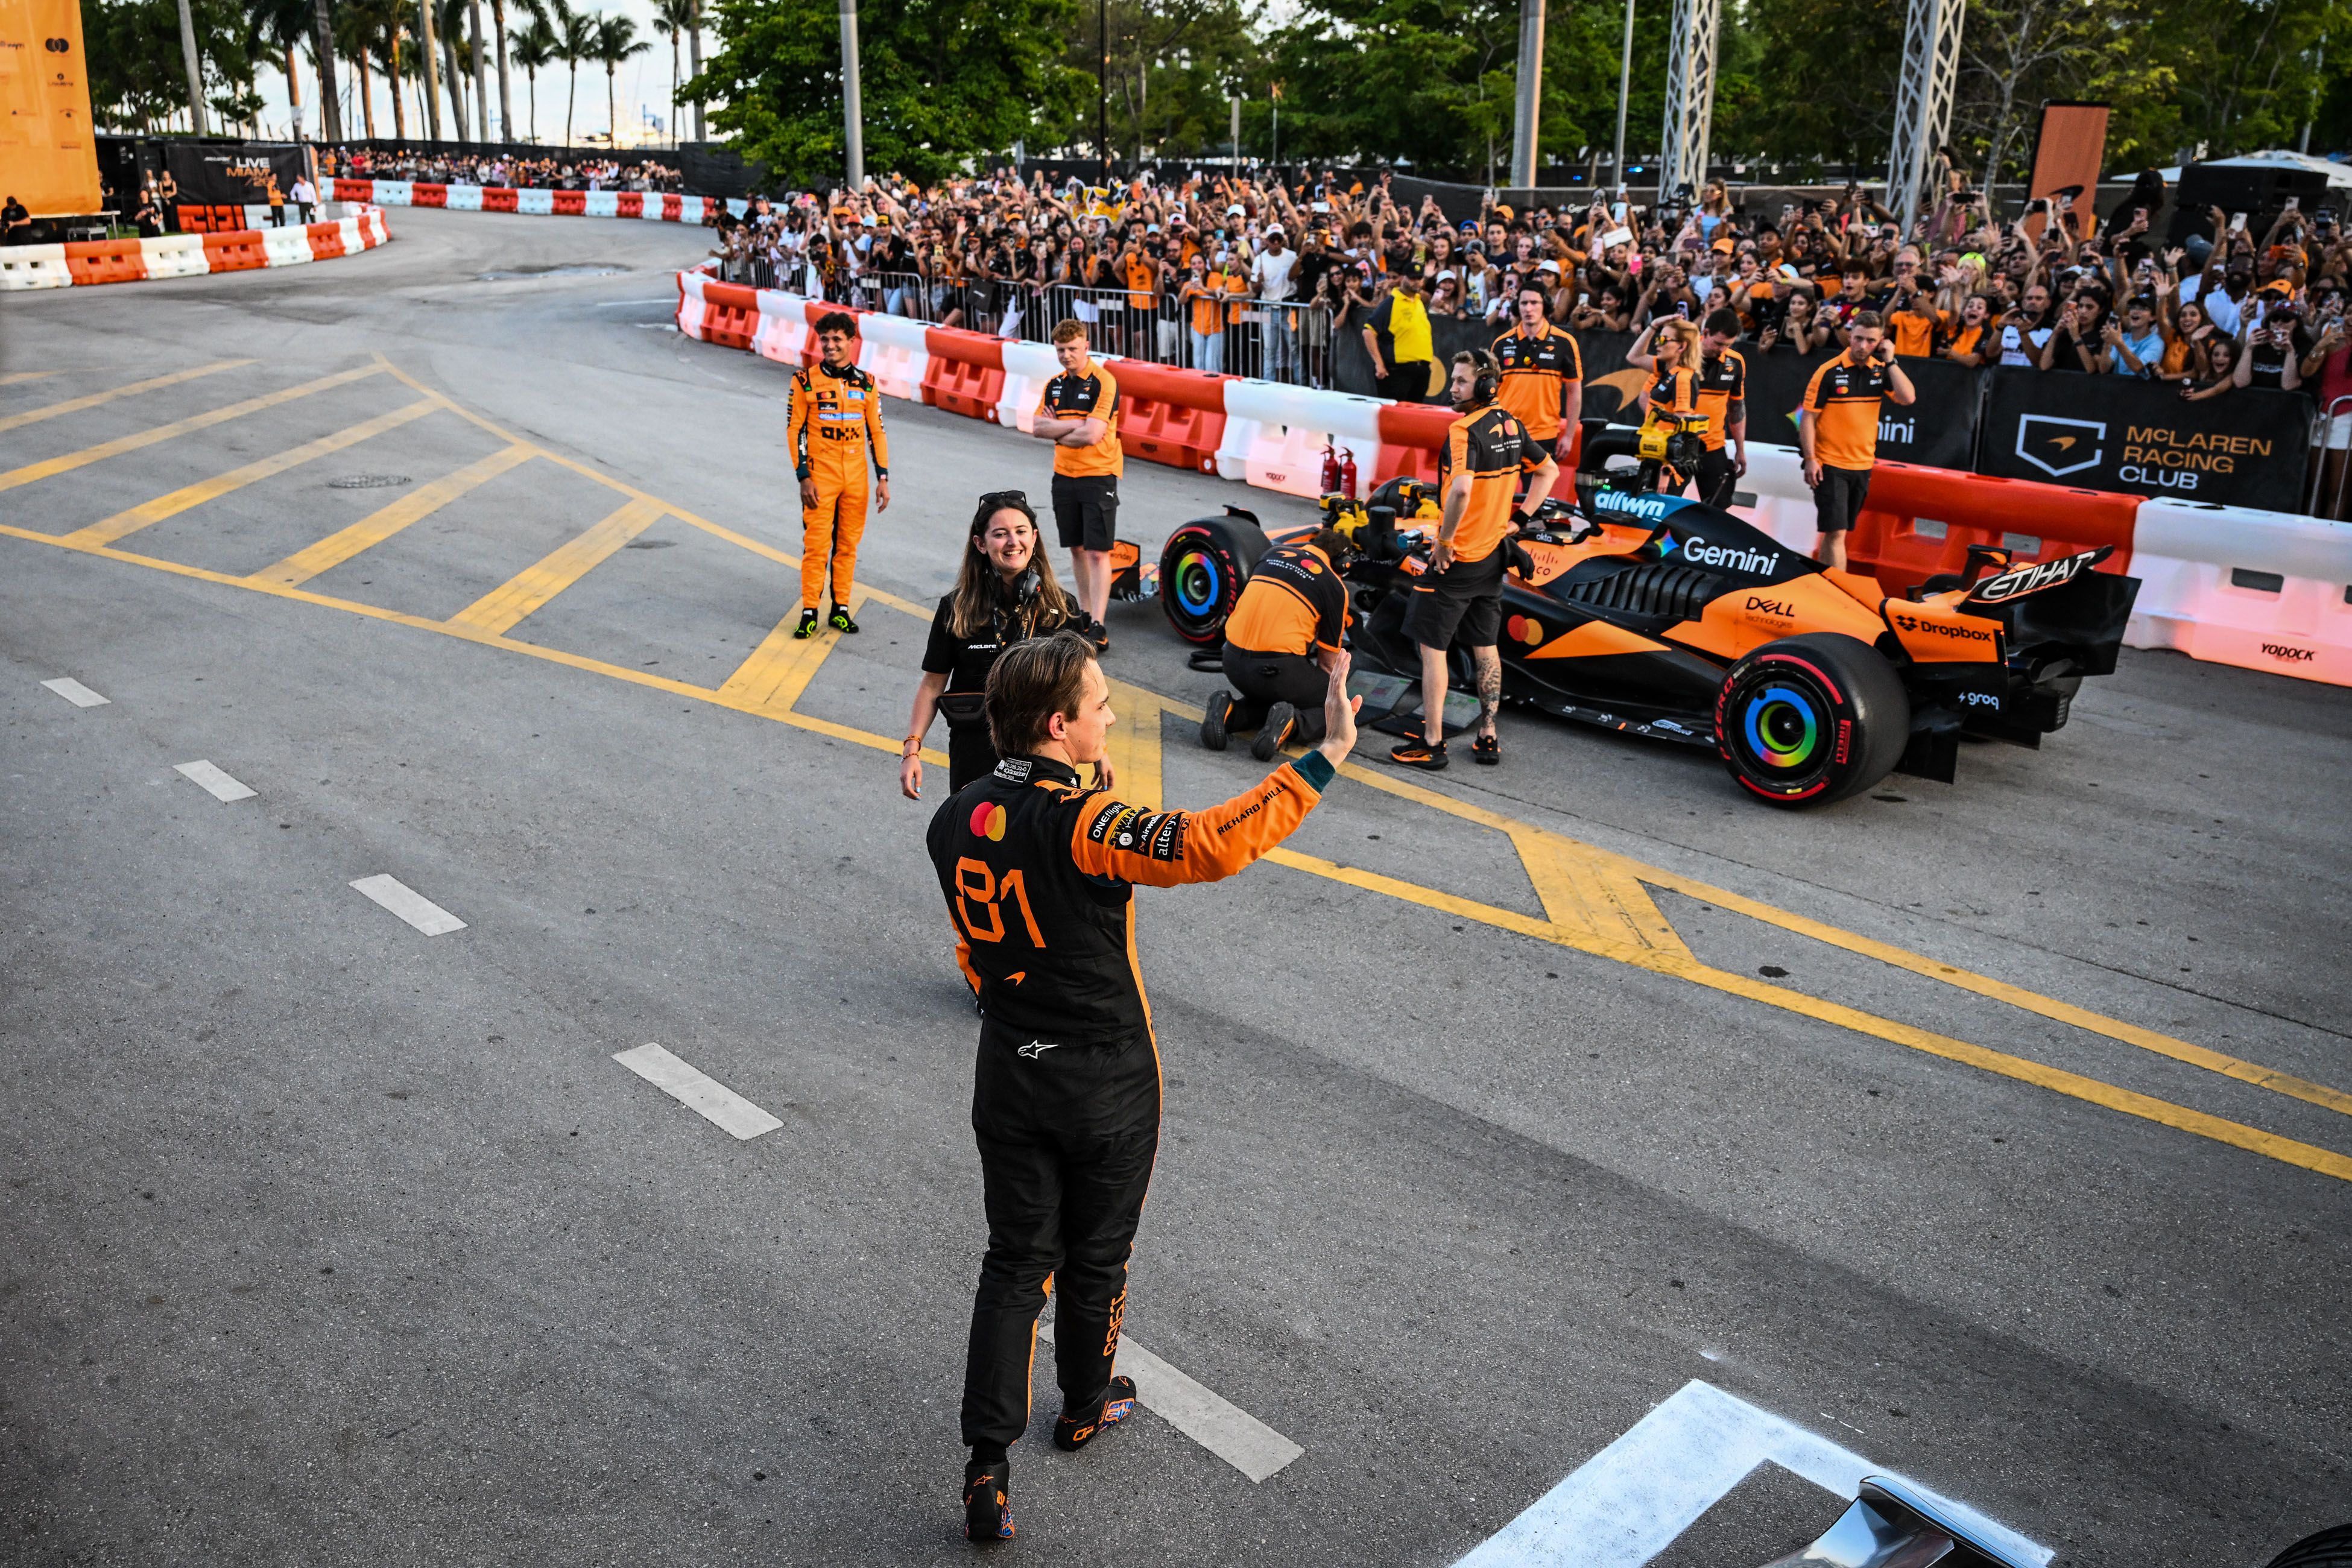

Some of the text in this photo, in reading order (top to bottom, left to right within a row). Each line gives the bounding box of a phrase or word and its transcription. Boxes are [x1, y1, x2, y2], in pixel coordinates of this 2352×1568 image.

[236, 157, 270, 168] LIVE
[2123, 446, 2235, 473] RACING
[2119, 465, 2199, 490] CLUB
[1595, 492, 1666, 518] allwyn
[1535, 533, 1552, 543] okta
[1684, 536, 1780, 576] Gemini
[1746, 596, 1795, 618] DELL
[1920, 621, 1992, 643] Dropbox
[2262, 643, 2315, 661] YODOCK
[1967, 692, 2000, 711] groq
[1093, 804, 1125, 838] ONEflight
[1216, 803, 1261, 835] RICHARD
[955, 856, 1046, 948] 81
